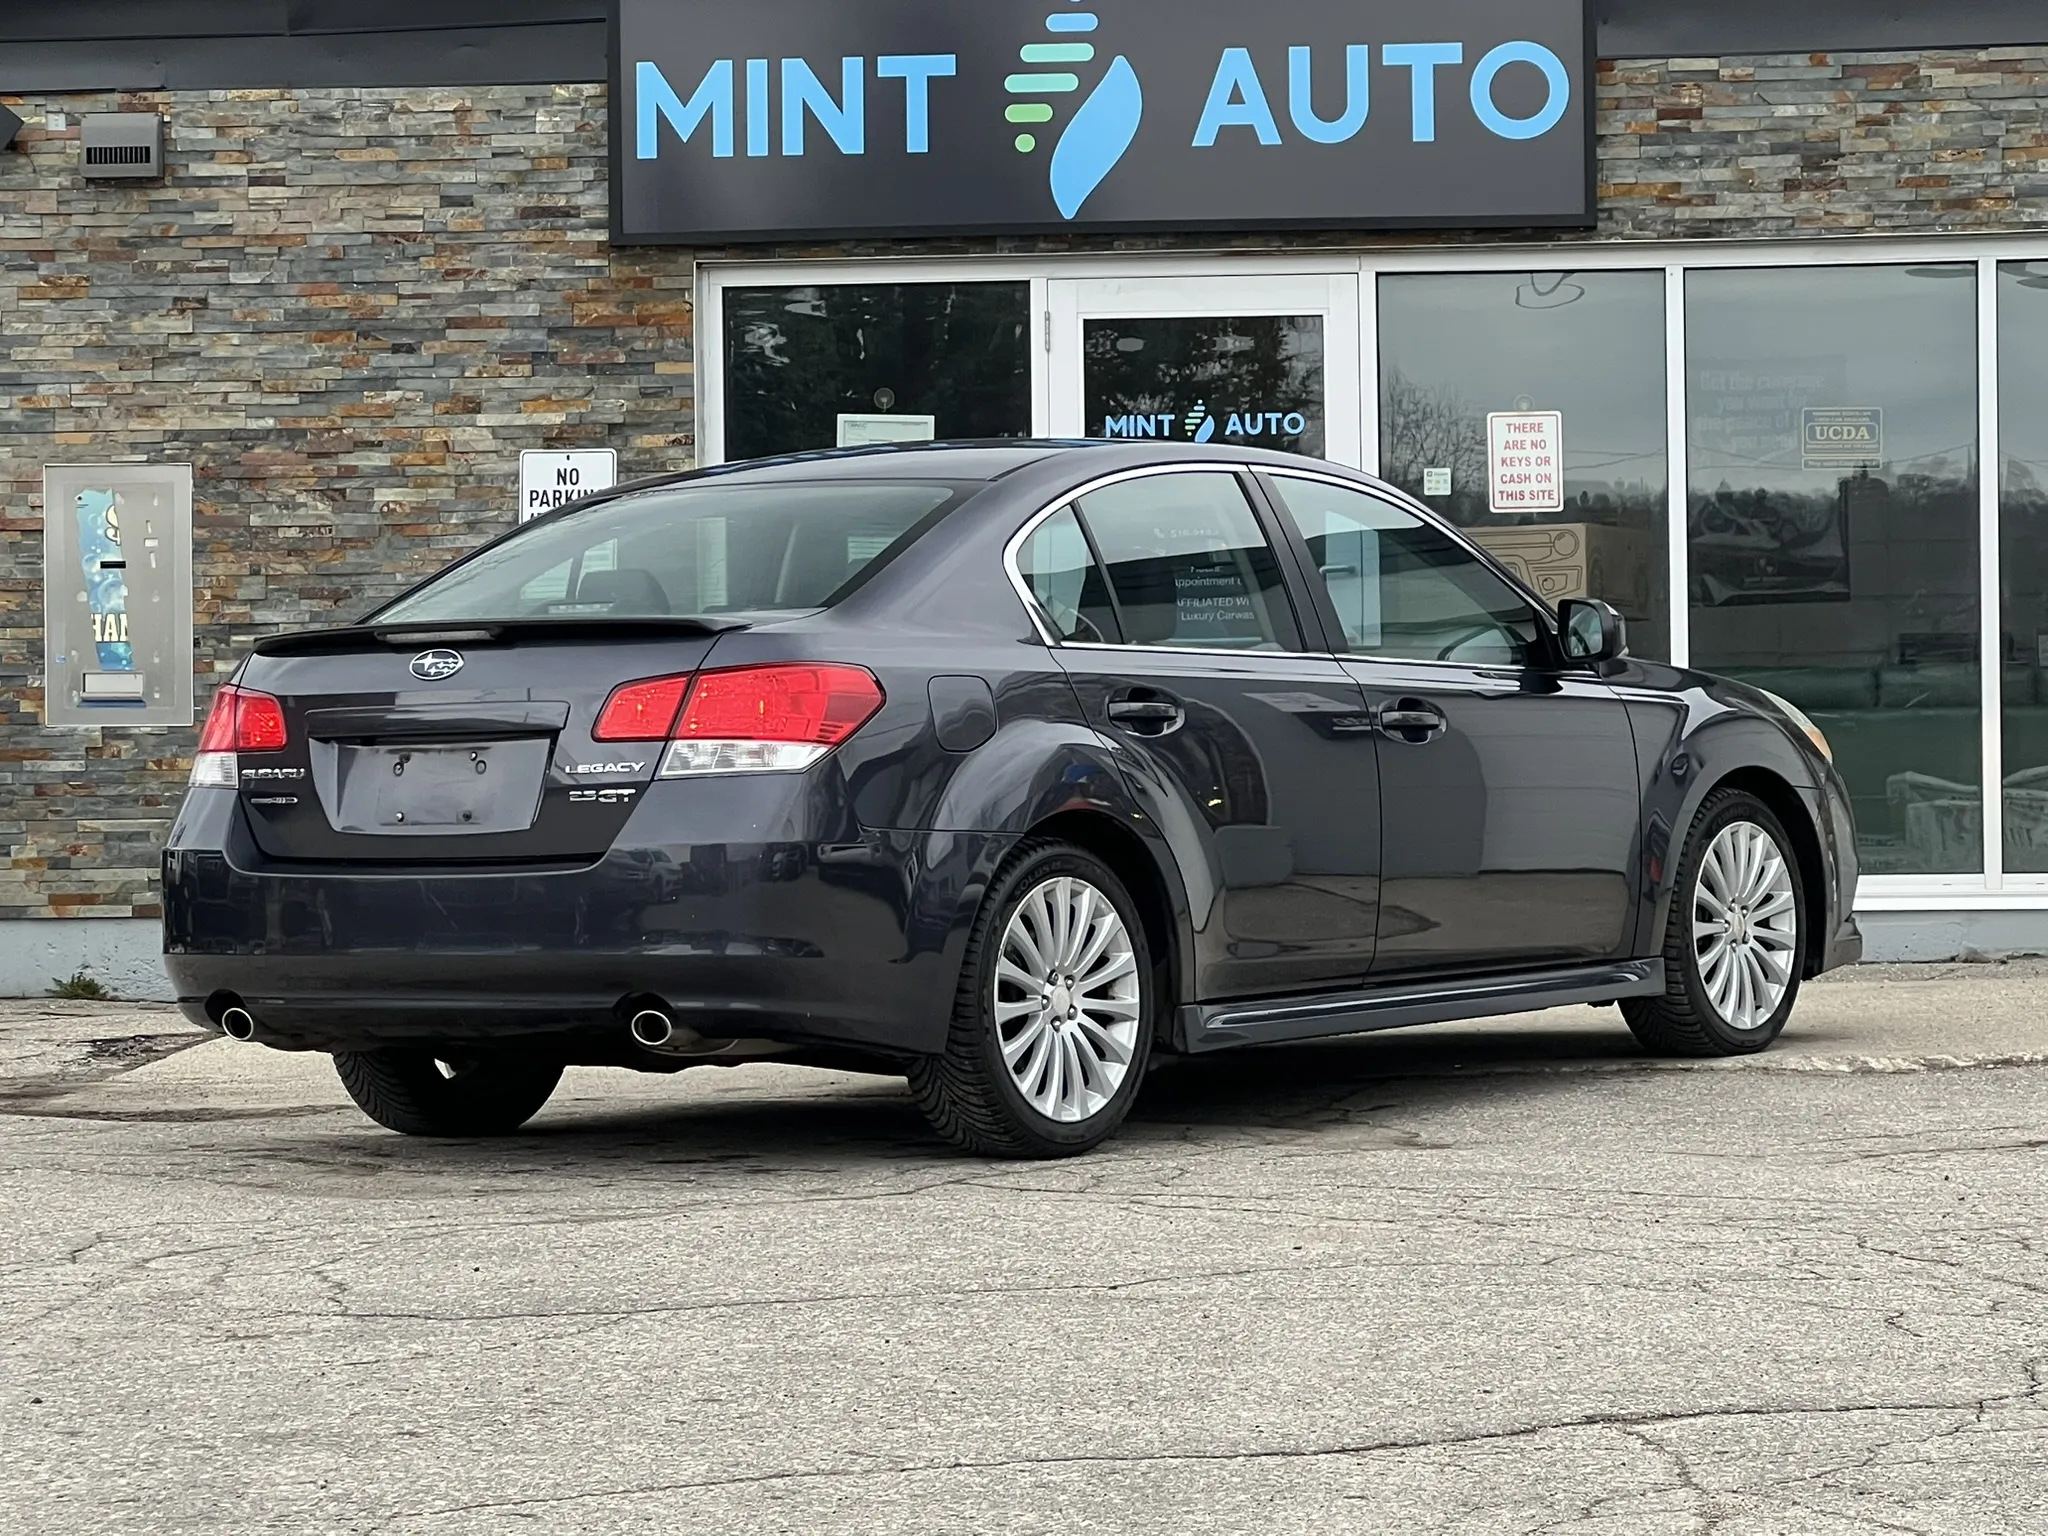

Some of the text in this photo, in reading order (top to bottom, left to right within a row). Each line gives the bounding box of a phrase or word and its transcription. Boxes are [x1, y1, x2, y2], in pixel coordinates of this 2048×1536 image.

[636, 41, 1570, 159] MINT AUTO
[1105, 412, 1305, 437] MINT AUTO
[1506, 422, 1544, 434] THERE
[1815, 426, 1870, 440] UCDA
[1504, 439, 1547, 450] ARE NO
[1501, 456, 1551, 467] KEYS OR
[556, 468, 579, 486] NO
[1500, 473, 1552, 484] CASH ON
[1499, 489, 1554, 501] THIS SITE
[1181, 610, 1254, 622] Luxury Carwas
[565, 762, 645, 774] LEGACY
